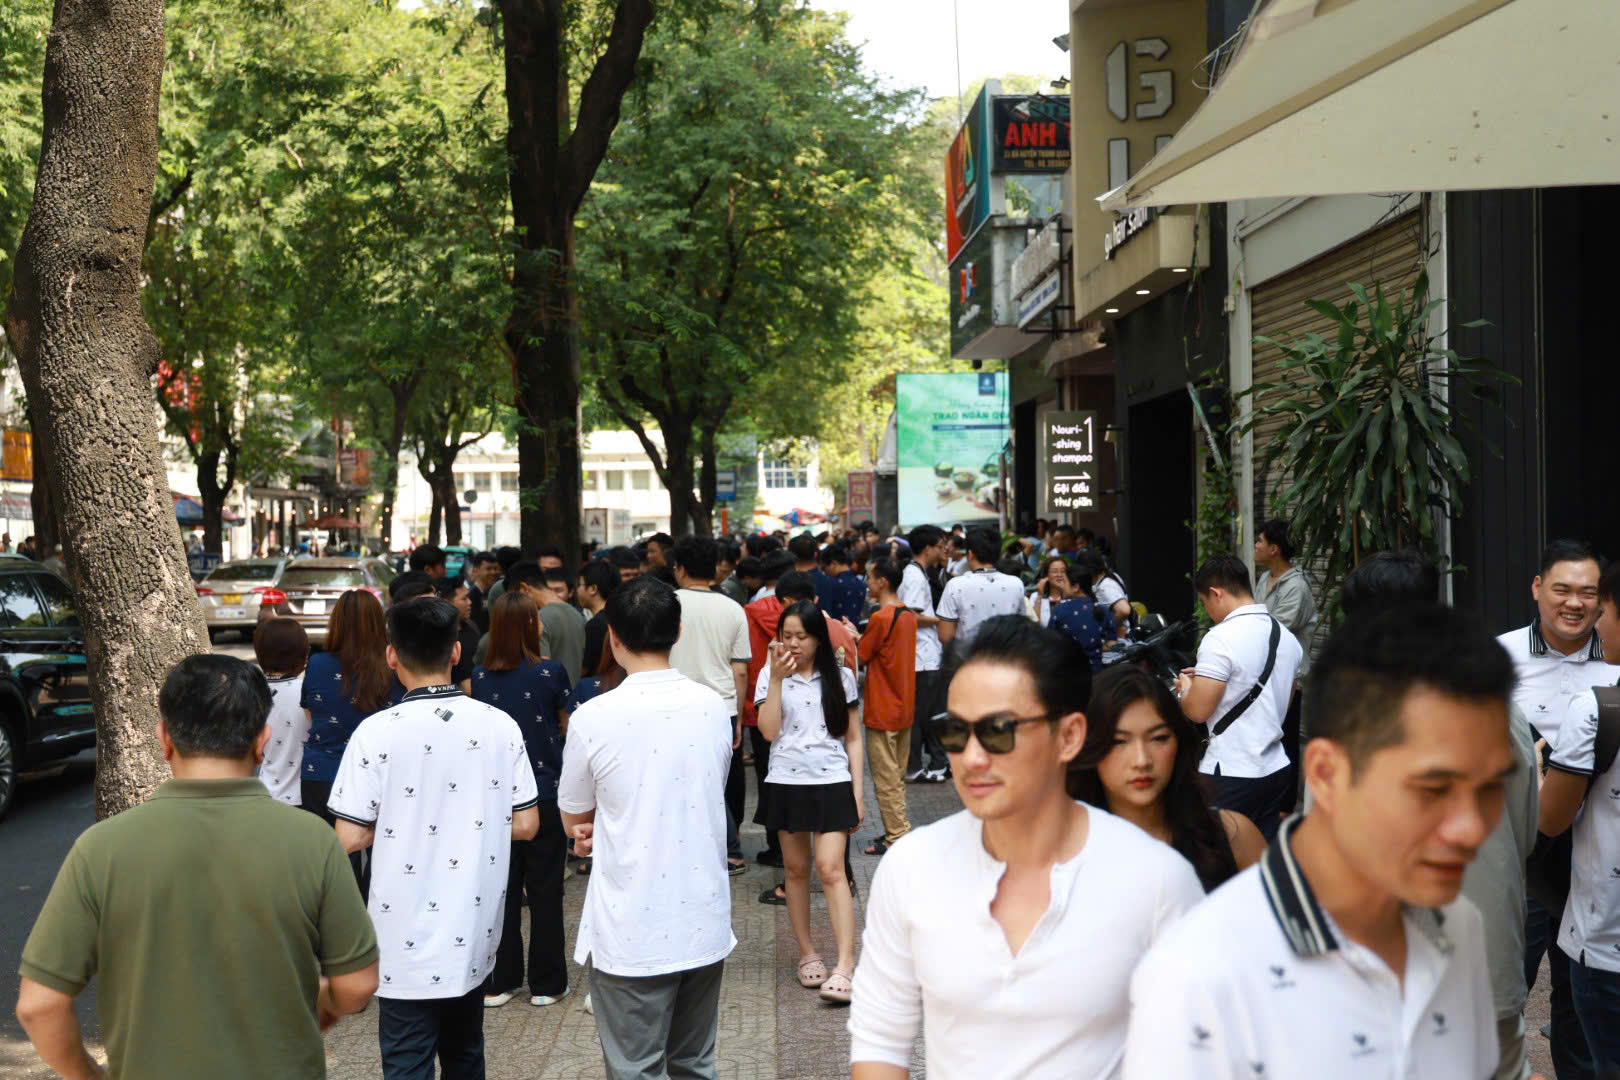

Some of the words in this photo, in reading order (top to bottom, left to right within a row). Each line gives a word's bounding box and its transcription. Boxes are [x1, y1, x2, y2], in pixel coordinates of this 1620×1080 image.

[1004, 122, 1057, 147] ANH
[1051, 425, 1083, 434] Nouri-
[1052, 439, 1081, 451] -shing
[1052, 454, 1093, 465] shampoo
